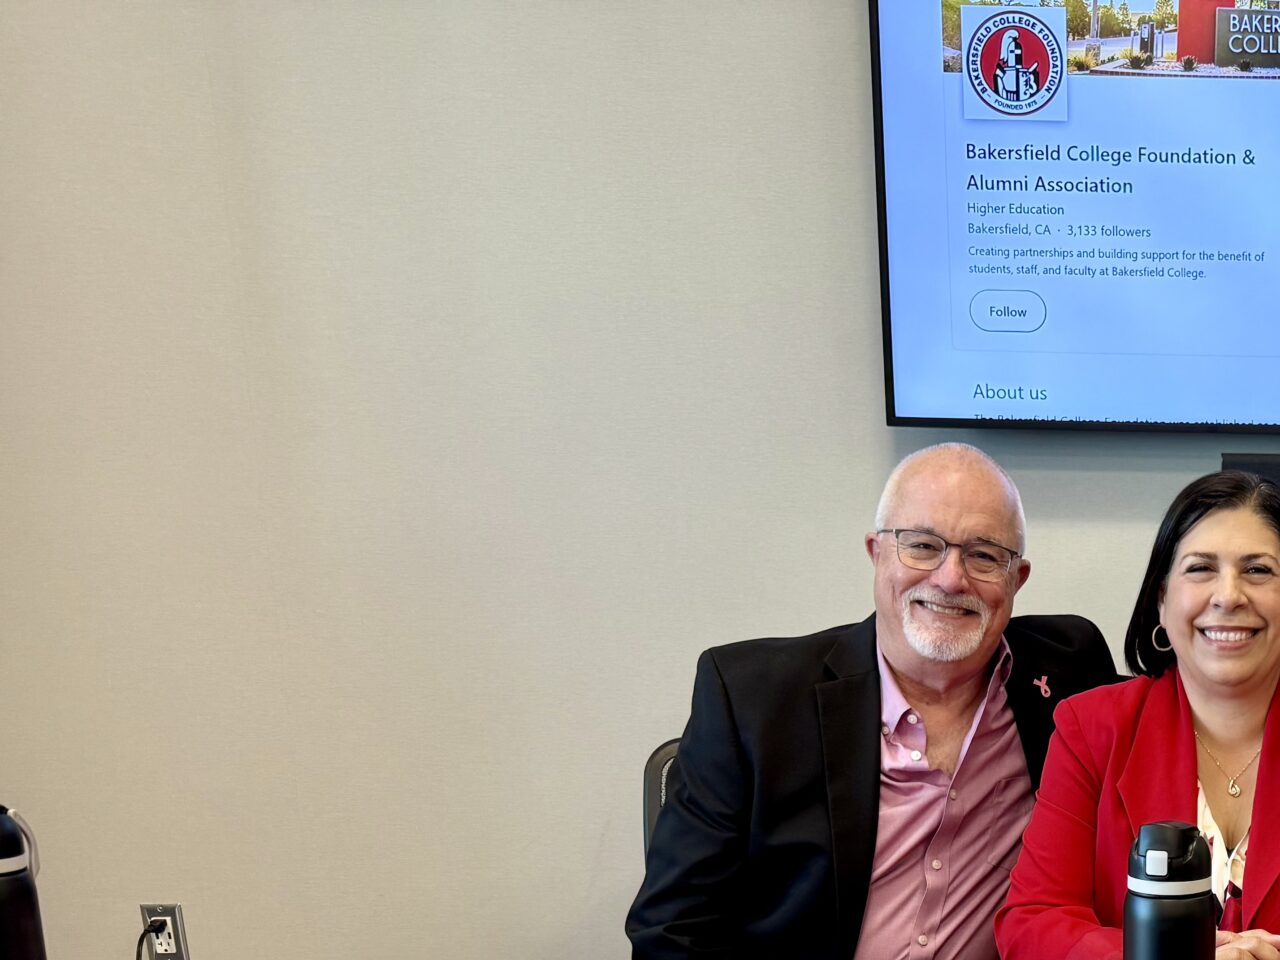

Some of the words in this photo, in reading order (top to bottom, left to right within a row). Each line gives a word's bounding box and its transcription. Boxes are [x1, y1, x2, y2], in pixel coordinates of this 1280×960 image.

[971, 26, 992, 95] BAKERSFIELD
[992, 16, 1038, 30] COLLEGE
[1038, 28, 1059, 94] FOUNDATION
[994, 99, 1023, 111] FOUNDED
[966, 144, 1060, 162] Bakersfield
[1067, 146, 1132, 167] College
[1138, 148, 1236, 165] Foundation
[1242, 150, 1256, 165] &
[966, 174, 1028, 192] Alumni
[1034, 176, 1133, 194] Association
[967, 203, 1006, 217] Higher
[1009, 204, 1064, 215] Education
[968, 224, 1032, 236] Bakersfield,
[1035, 224, 1051, 236] CA
[1067, 225, 1097, 237] 3,133
[1101, 225, 1151, 237] followers
[968, 247, 1010, 259] Creating
[1013, 248, 1074, 260] partnerships
[1076, 248, 1095, 259] and
[1098, 248, 1138, 261] building
[1141, 250, 1179, 262] support
[1182, 250, 1196, 261] for
[1199, 250, 1215, 261] the
[1218, 250, 1252, 261] benefit
[1254, 251, 1265, 262] of
[968, 264, 1014, 276] students,
[1016, 265, 1040, 276] staff,
[1042, 266, 1061, 275] and
[1064, 266, 1097, 278] faculty
[1100, 267, 1109, 276] at
[1112, 267, 1165, 277] Bakersfield
[1167, 267, 1207, 280] College.
[990, 306, 1027, 318] Follow
[973, 384, 1025, 400] About
[1030, 388, 1048, 400] us
